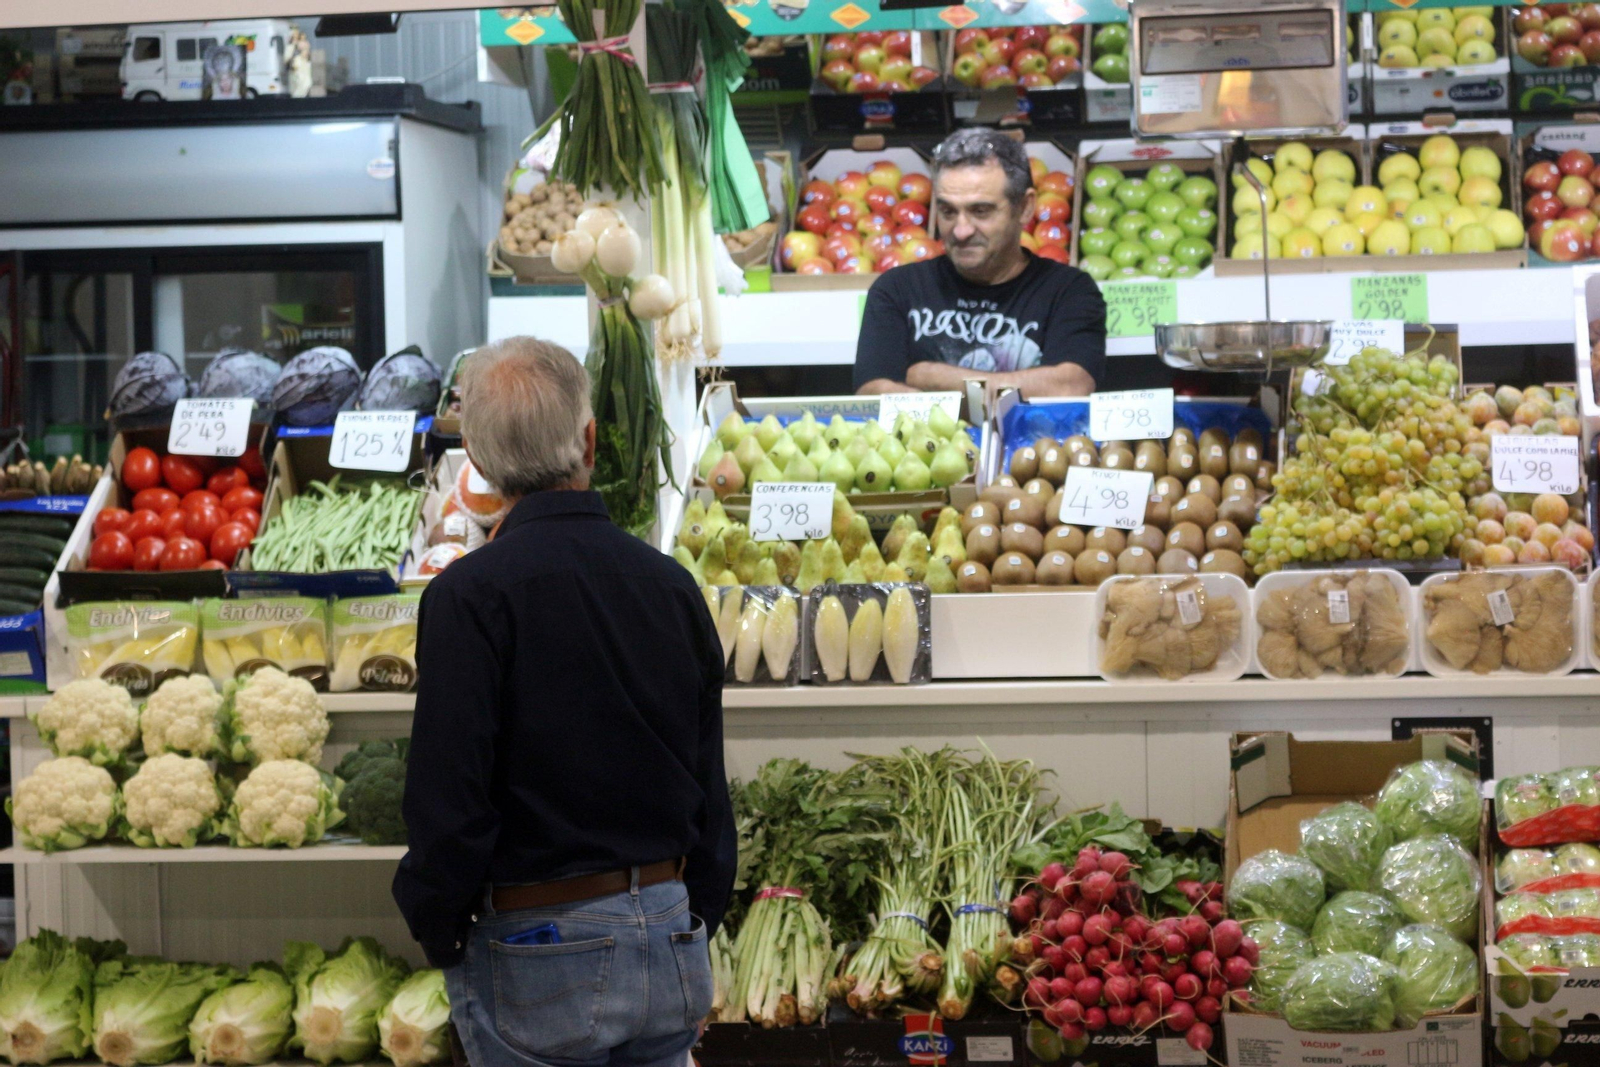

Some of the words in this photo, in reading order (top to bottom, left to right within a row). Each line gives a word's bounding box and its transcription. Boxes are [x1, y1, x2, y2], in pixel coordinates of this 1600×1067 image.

[1357, 276, 1422, 287] MANZANAS
[1108, 285, 1167, 294] MANZANAS
[1365, 288, 1409, 298] GOLDEN
[1131, 392, 1155, 400] ORO
[187, 401, 235, 410] TOMATES
[843, 403, 859, 414] LA
[181, 411, 194, 420] DE
[198, 411, 224, 419] PERA
[377, 414, 410, 423] VERDES
[1096, 406, 1152, 432] 7'98
[174, 420, 227, 448] 2'49
[1494, 447, 1521, 455] DULCE
[1525, 447, 1549, 455] COMO
[1092, 470, 1121, 478] KIWI
[1499, 458, 1553, 486] 4'98
[756, 484, 832, 494] CONFERENCIAS
[1068, 485, 1130, 517] 4'98
[755, 503, 810, 534] 3'98
[867, 513, 896, 524] OYA
[1301, 1040, 1342, 1049] VACUUM
[1302, 1056, 1343, 1064] ICEBERG
